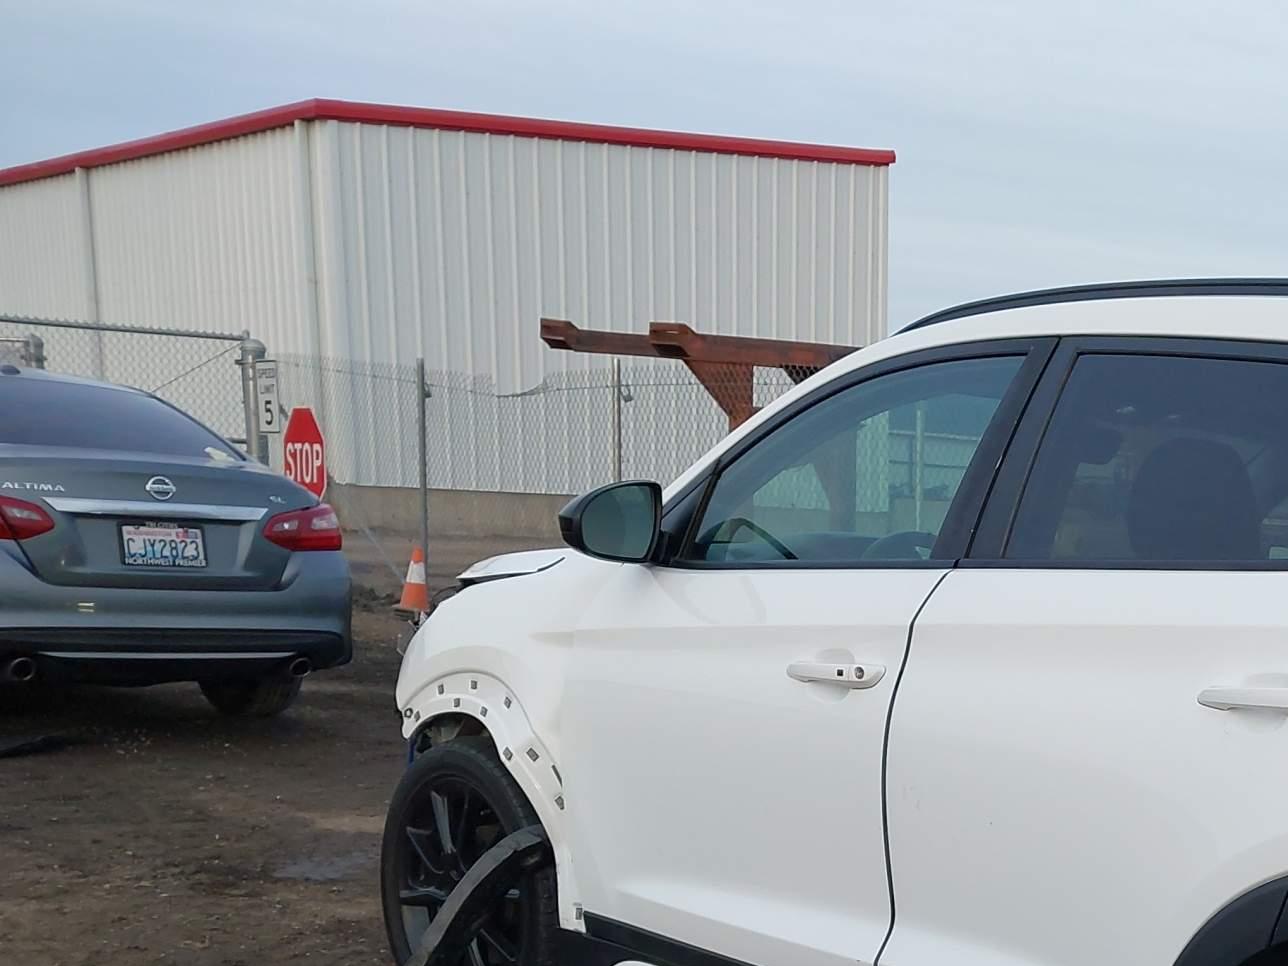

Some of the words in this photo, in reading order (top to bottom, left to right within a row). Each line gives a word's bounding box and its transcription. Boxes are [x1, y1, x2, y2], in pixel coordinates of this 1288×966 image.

[264, 400, 274, 426] 5
[286, 442, 322, 484] STOP
[1, 481, 65, 492] ALTIMA
[126, 537, 200, 561] CJY2823
